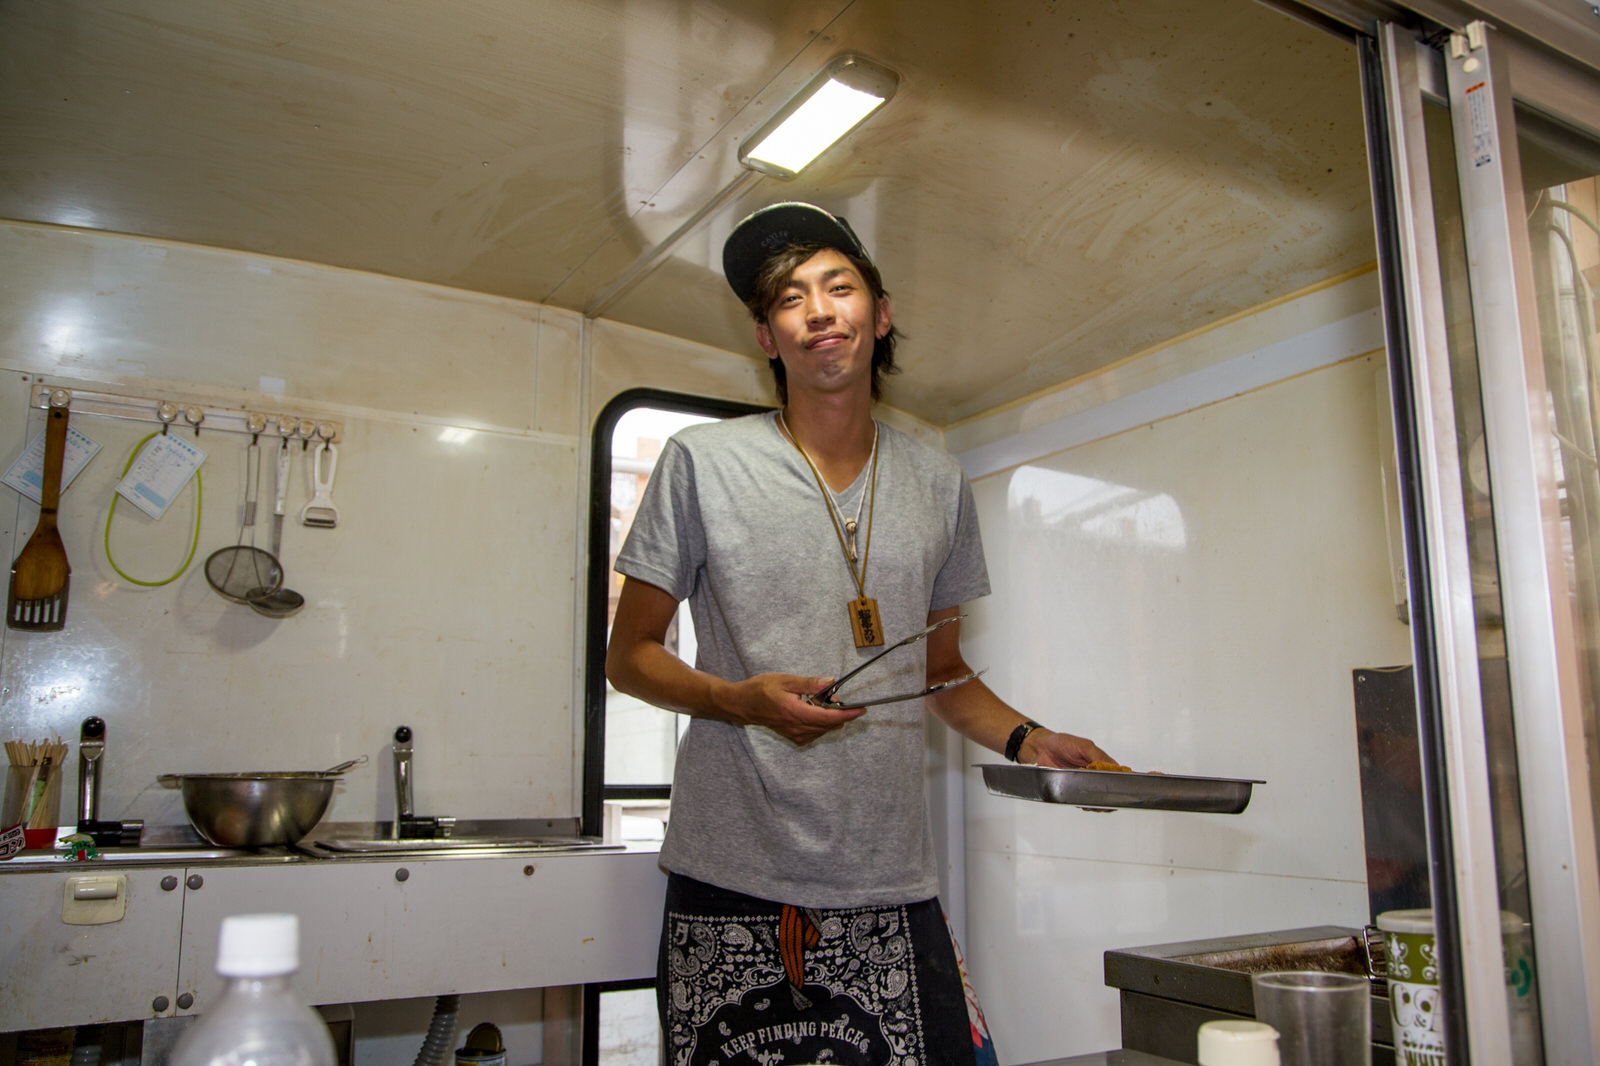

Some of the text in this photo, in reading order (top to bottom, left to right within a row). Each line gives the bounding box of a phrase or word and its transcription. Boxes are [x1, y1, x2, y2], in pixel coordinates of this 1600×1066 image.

[720, 1021, 865, 1059] KEEP FINDING PEACE
